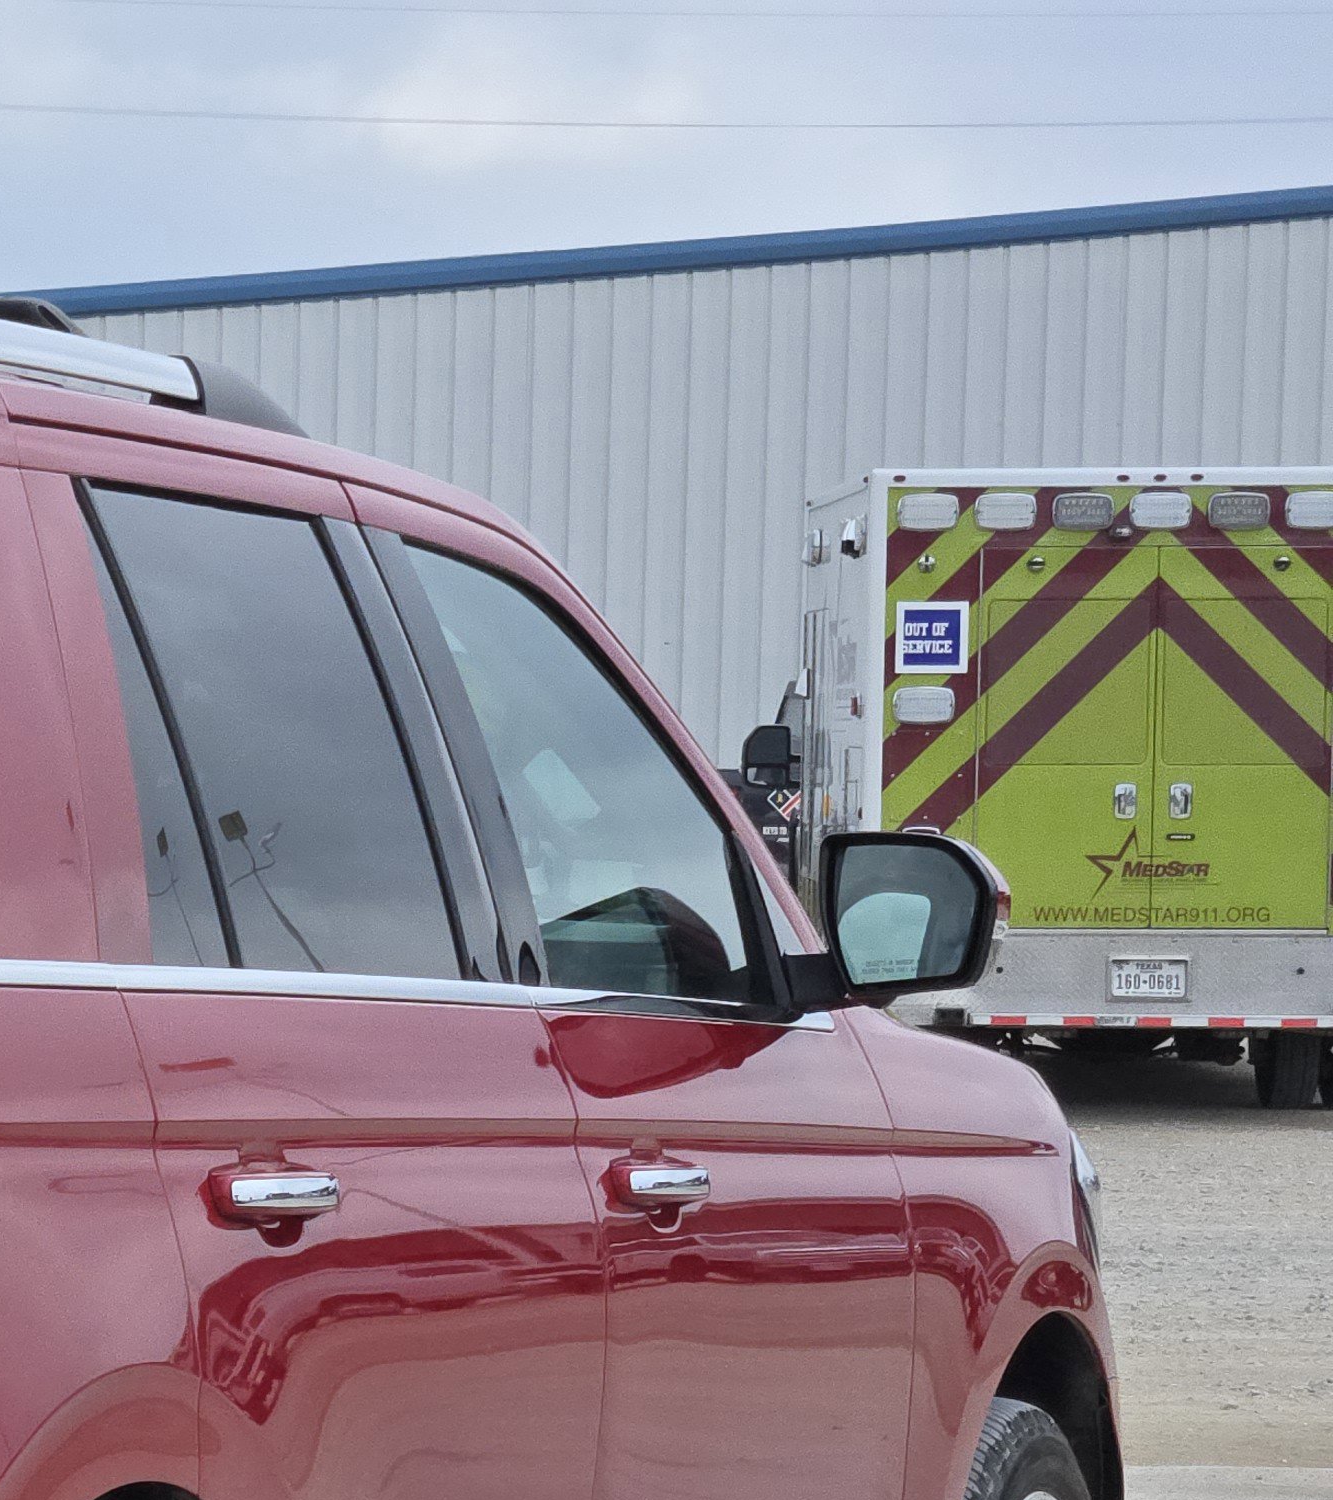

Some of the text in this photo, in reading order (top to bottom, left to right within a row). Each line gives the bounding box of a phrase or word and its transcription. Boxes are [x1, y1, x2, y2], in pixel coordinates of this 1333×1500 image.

[904, 623, 949, 636] OUT OF
[902, 640, 953, 654] SERVICE
[1034, 906, 1271, 923] WWW.MEDSTAR911.ORG
